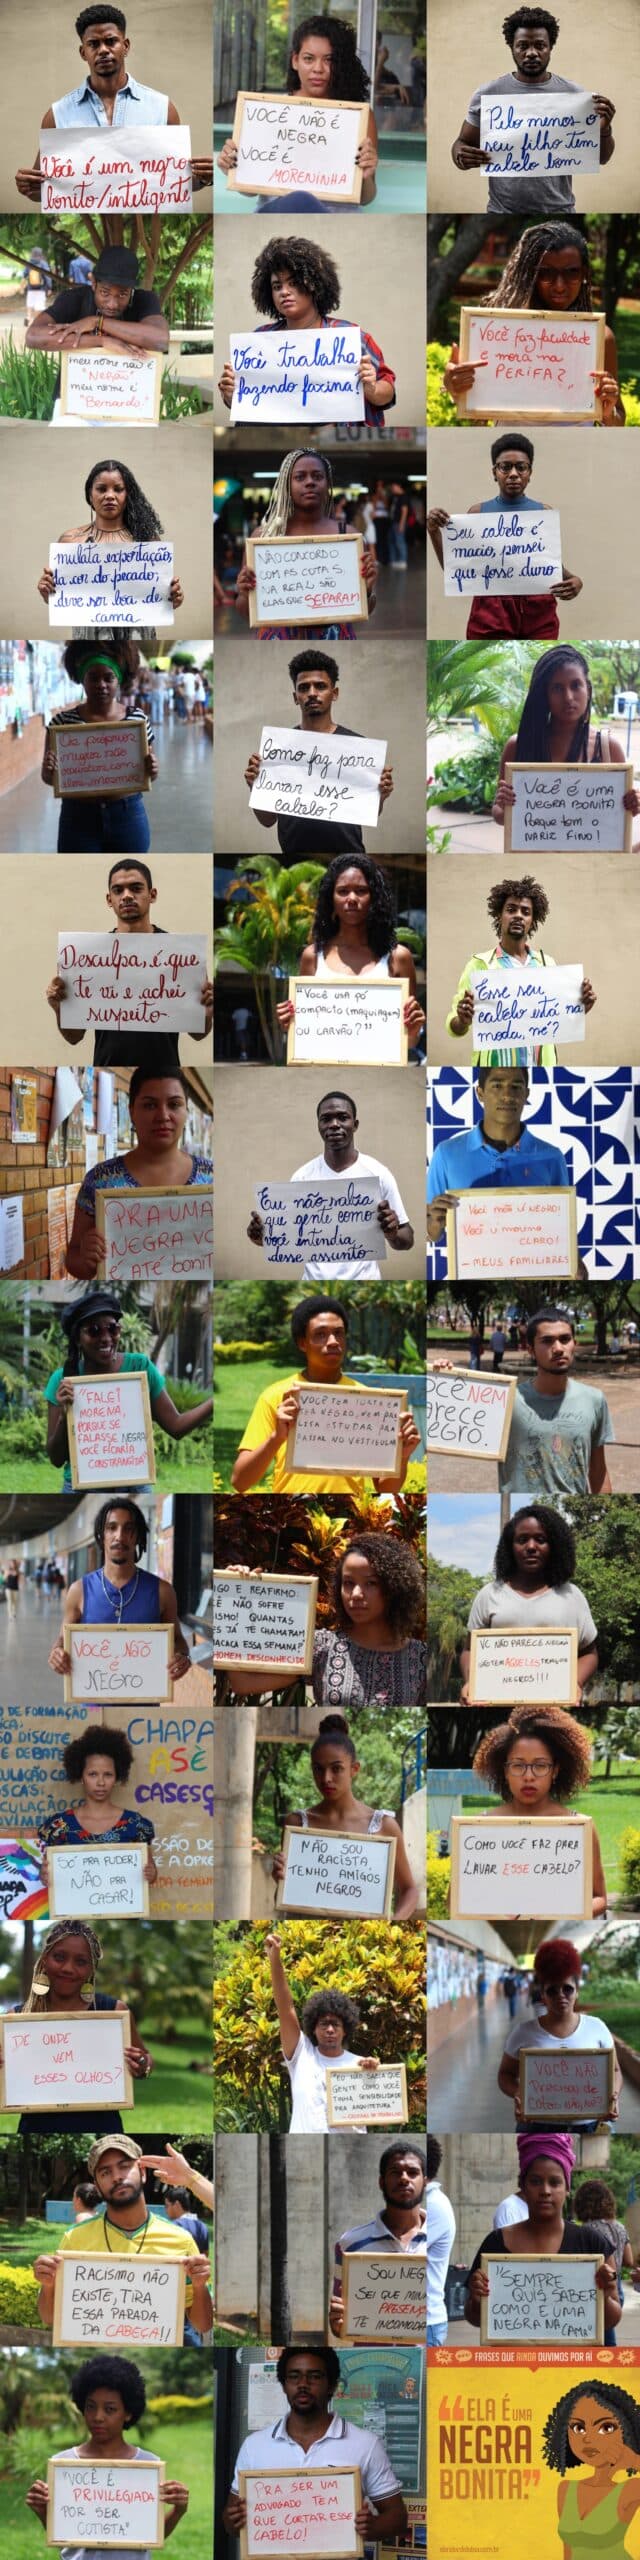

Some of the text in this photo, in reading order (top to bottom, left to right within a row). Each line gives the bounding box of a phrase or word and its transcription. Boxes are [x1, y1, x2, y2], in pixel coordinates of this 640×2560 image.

[247, 106, 340, 129] VOCÊ NÃO É
[486, 106, 598, 129] Pelo menos o
[277, 129, 328, 145] NEGRA
[521, 129, 598, 159] filho tem
[241, 145, 294, 163] VOCÊ É
[544, 152, 581, 169] bom
[43, 156, 191, 187] Você é um negro
[44, 177, 191, 213] bonito/inteligente
[234, 336, 357, 371] Você trabalha
[237, 373, 298, 406] fazendo
[446, 514, 544, 541] Seu cabelo é
[54, 544, 100, 564] mulata
[500, 538, 545, 566] pensei
[70, 565, 110, 584] cor do
[482, 557, 559, 590] fosse duro
[54, 587, 162, 607] deve ser boa de
[91, 613, 141, 623] cama
[263, 739, 375, 779] Como faz para
[314, 785, 354, 800] esse
[524, 778, 581, 797] Você é
[149, 950, 200, 982] é que
[73, 973, 186, 999] te e achei
[475, 978, 545, 1001] Esse seu
[86, 1000, 170, 1028] suspeito
[565, 1004, 584, 1015] na
[258, 1182, 374, 1210] Eu não sabia
[105, 1200, 213, 1229] PRA UMA
[264, 1206, 375, 1237] que gente como
[111, 1232, 184, 1258] NEGRA
[264, 1233, 289, 1246] você
[268, 1244, 377, 1263] desse assunto
[132, 1256, 165, 1279] ATÉ
[236, 1585, 242, 1593] E
[233, 1596, 285, 1610] NÃO SOFRE
[249, 1613, 294, 1625] QUANTAS
[226, 1623, 239, 1633] JÁ
[261, 1627, 305, 1637] CHAMARAM
[243, 1641, 261, 1650] ESSA
[18, 1729, 71, 1746] DISCUTE
[128, 1718, 214, 1745] CHAPA
[302, 1839, 363, 1855] NÃO SOU
[532, 1839, 551, 1849] FAZ
[318, 1853, 368, 1866] RACISTA
[464, 1860, 529, 1876] LAVAR ESSE
[71, 1870, 102, 1889] NÃO
[288, 1864, 328, 1878] TENHO
[316, 1881, 362, 1897] NEGROS
[12, 2032, 71, 2048] DE ONDE
[53, 2050, 73, 2063] VEM
[34, 2073, 67, 2085] ESSES
[75, 2265, 134, 2282] RACISMO
[367, 2264, 396, 2280] SOU
[120, 2289, 152, 2305] TIRA
[355, 2287, 376, 2300] SEI
[512, 2287, 597, 2303] QUIS SABER
[72, 2308, 159, 2323] ESSA PARADA
[492, 2304, 585, 2318] COMO UMA
[82, 2323, 100, 2335] DA
[353, 2316, 368, 2328] TE
[494, 2318, 560, 2330] NEGRA NA
[475, 2352, 499, 2361] FRASES
[501, 2352, 514, 2361] QUE
[538, 2352, 568, 2361] OUVIMOS
[570, 2352, 584, 2361] POR
[503, 2393, 532, 2421] É UMA
[440, 2425, 532, 2464] NEGRA
[107, 2469, 115, 2486] É
[73, 2488, 155, 2504] PRIVILEGIADA
[255, 2480, 338, 2498] PRA SER UM
[255, 2496, 338, 2511] ADVOGADO TEM
[95, 2507, 120, 2518] SER
[254, 2513, 352, 2526] QUE ESSE
